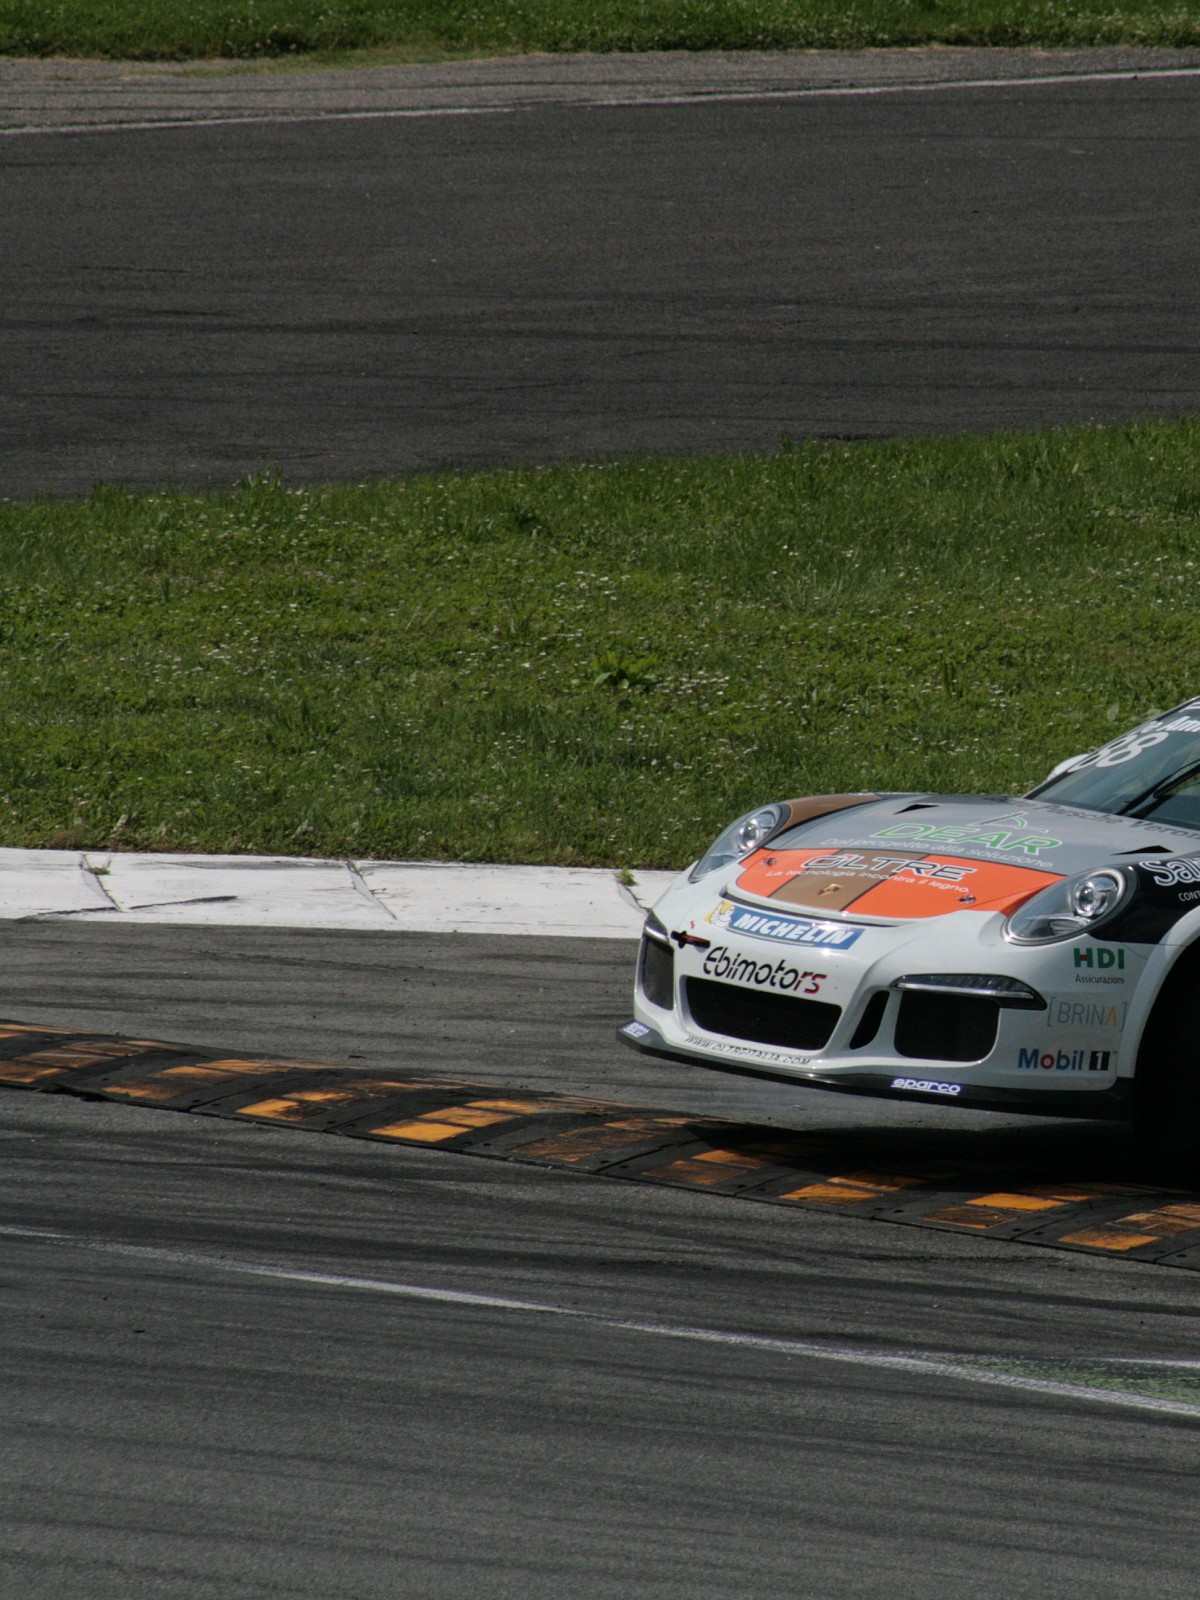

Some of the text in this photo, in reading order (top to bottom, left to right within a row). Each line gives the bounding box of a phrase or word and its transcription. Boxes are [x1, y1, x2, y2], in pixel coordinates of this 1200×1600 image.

[869, 822, 1063, 856] DEAR
[801, 853, 978, 882] OLTRE
[859, 871, 915, 884] incontra
[734, 913, 855, 945] MICHELIN
[703, 946, 827, 994] Ebimotors
[1074, 948, 1124, 970] HDI
[1075, 974, 1124, 985] Assicurazioni
[1018, 1048, 1084, 1071] Mobil
[891, 1078, 961, 1096] sparco
